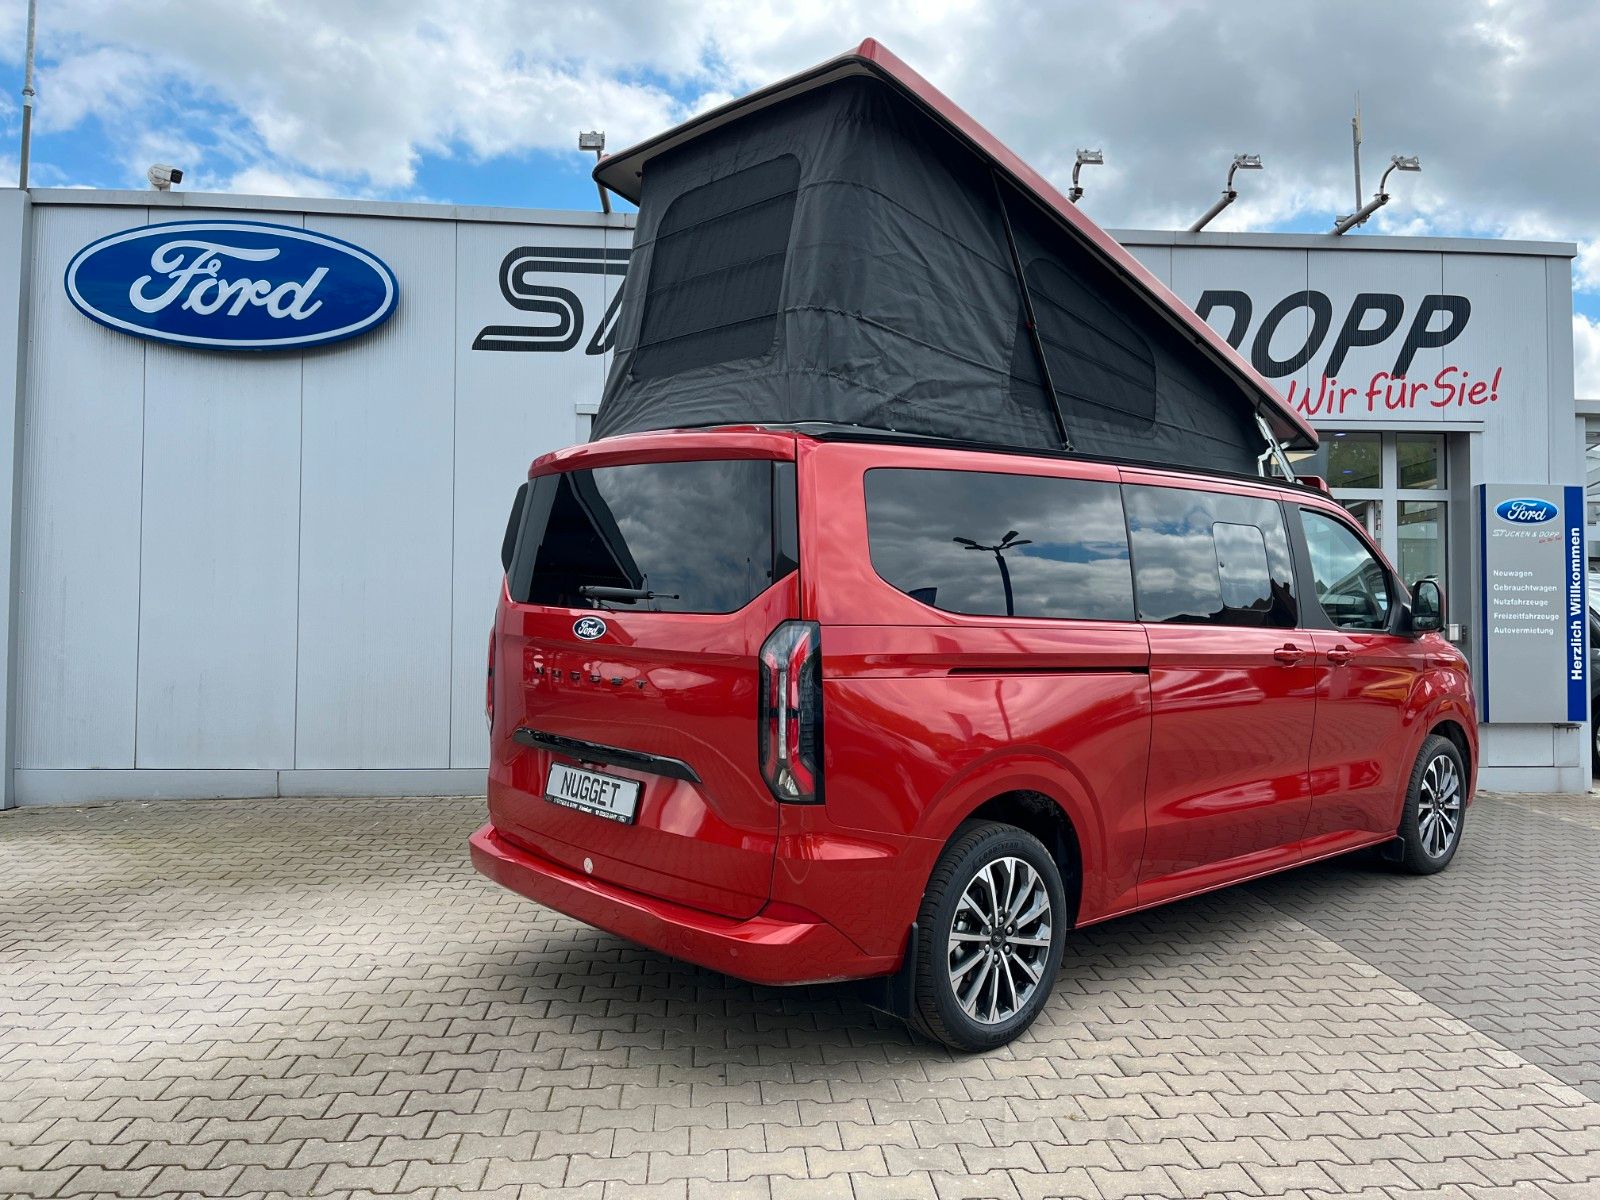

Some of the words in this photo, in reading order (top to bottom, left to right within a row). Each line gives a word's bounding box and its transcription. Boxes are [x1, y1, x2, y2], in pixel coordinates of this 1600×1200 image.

[129, 240, 330, 320] Ford
[1195, 289, 1472, 380] DOPP
[1286, 372, 1357, 416] Wir
[1365, 370, 1429, 413] für
[1430, 365, 1503, 408] Sie!
[1507, 501, 1547, 521] Ford
[1493, 570, 1533, 578] Neuwagen
[1569, 527, 1582, 617] Willkommen
[1493, 583, 1558, 592] Gebrauchtwagen
[1493, 598, 1549, 607] Nutzfahrzeuge
[1493, 612, 1560, 621] Freizeitfahrzeuge
[578, 620, 599, 636] Ford
[1493, 626, 1554, 635] Autovermietung
[1570, 620, 1583, 681] Herzlich
[560, 770, 621, 808] NUGGET
